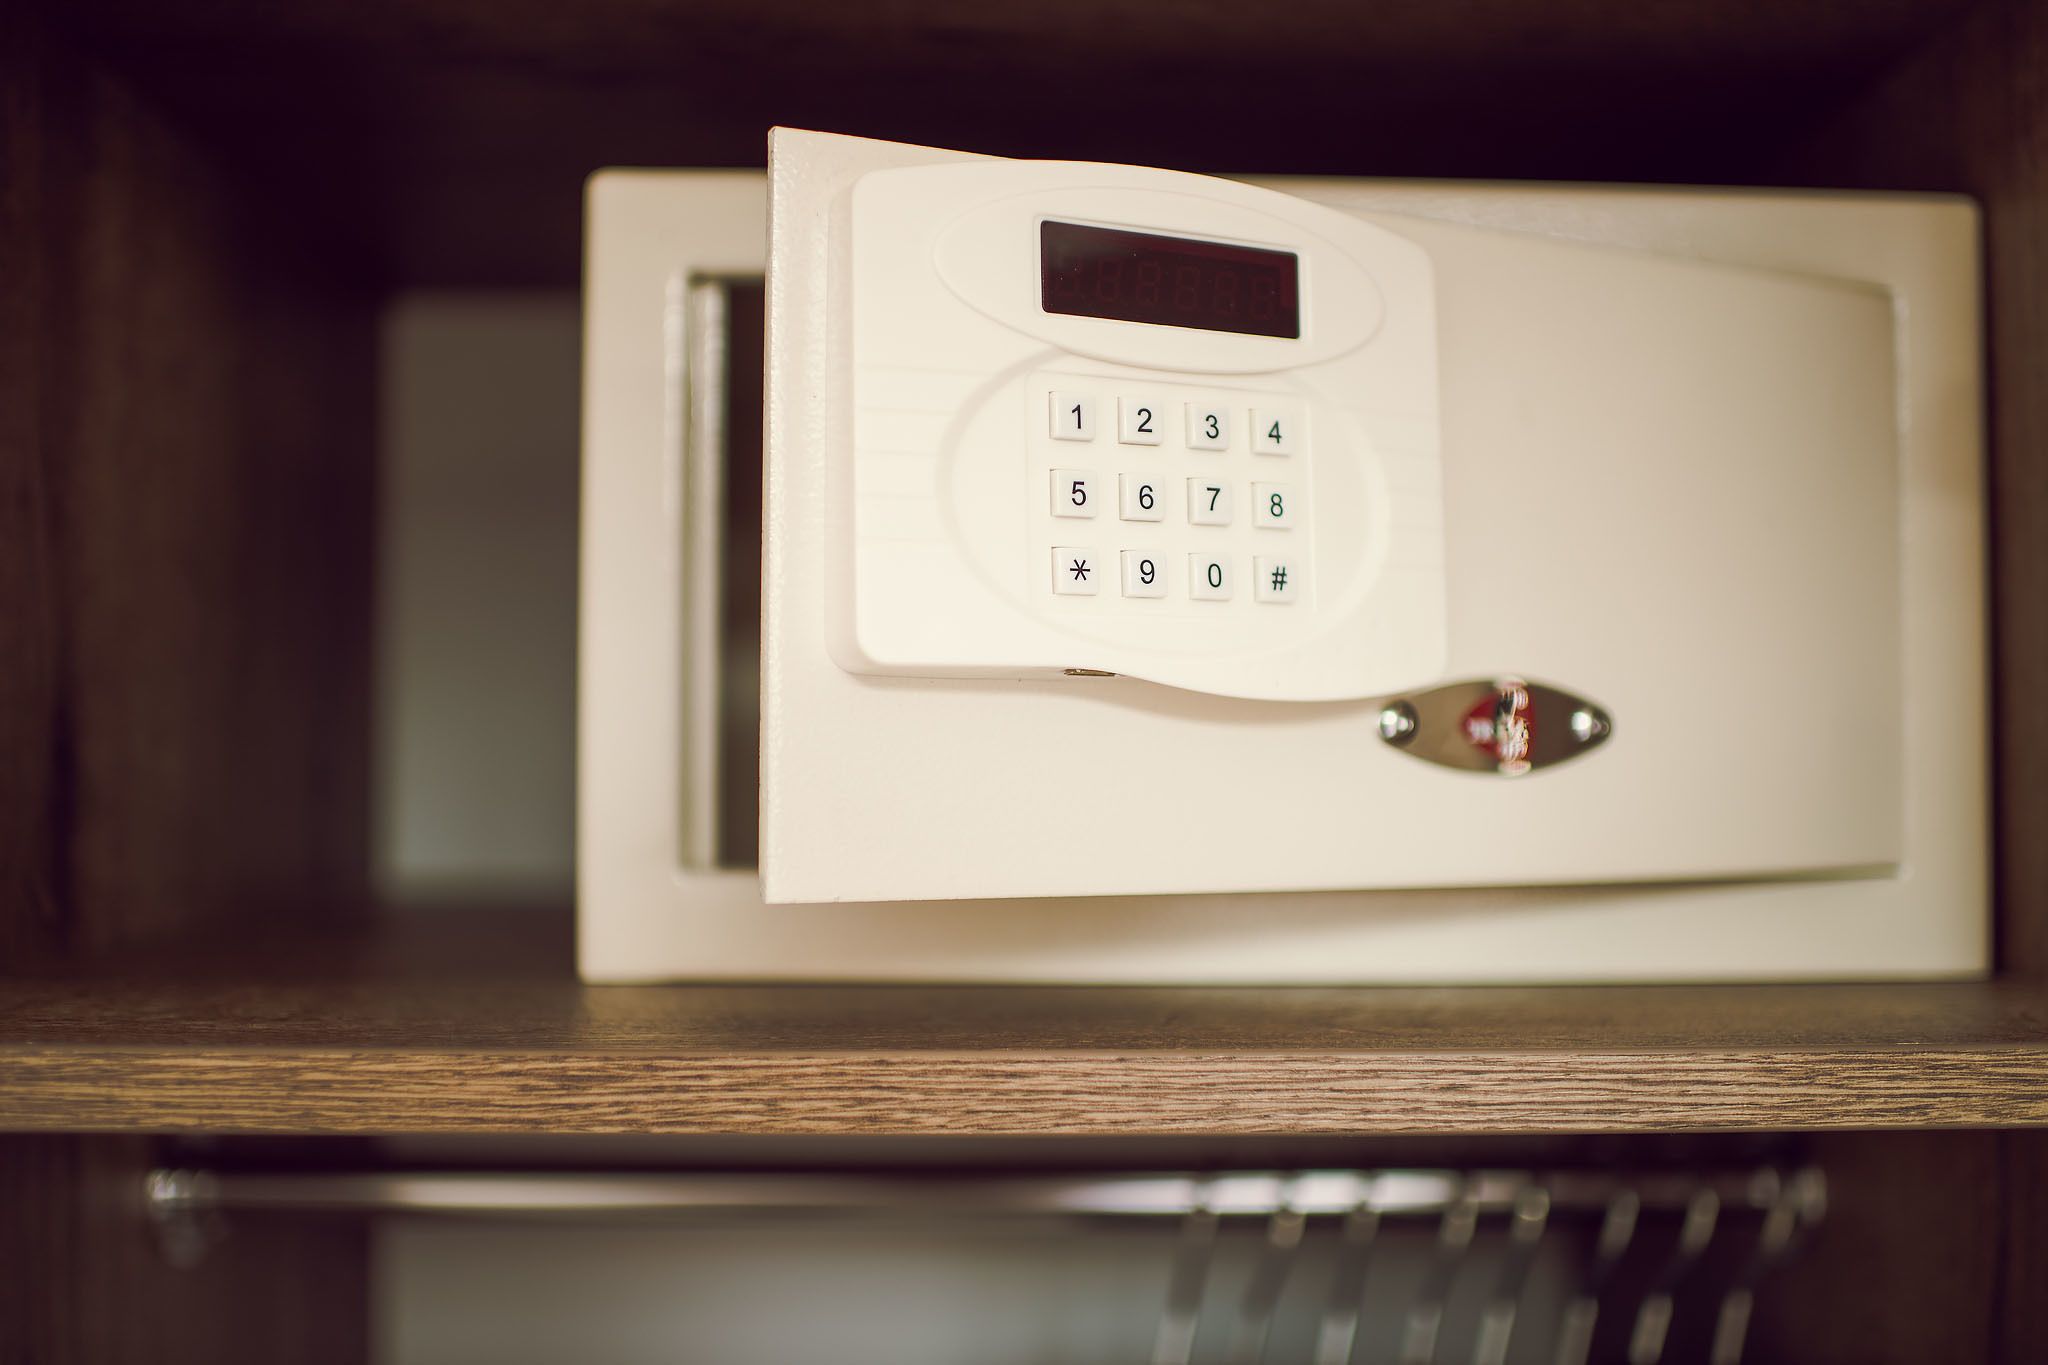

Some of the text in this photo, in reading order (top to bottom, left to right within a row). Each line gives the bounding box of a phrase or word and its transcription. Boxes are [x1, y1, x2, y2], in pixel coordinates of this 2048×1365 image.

[1071, 403, 1082, 430] 1
[1137, 407, 1153, 434] 2
[1205, 414, 1220, 440] 3
[1267, 420, 1283, 445] 4
[1071, 480, 1087, 507] 5
[1138, 484, 1155, 510] 6
[1206, 486, 1221, 512] 7
[1270, 493, 1284, 518] 8
[1139, 559, 1155, 585] 9
[1207, 563, 1222, 589] 0
[1271, 566, 1288, 592] #
